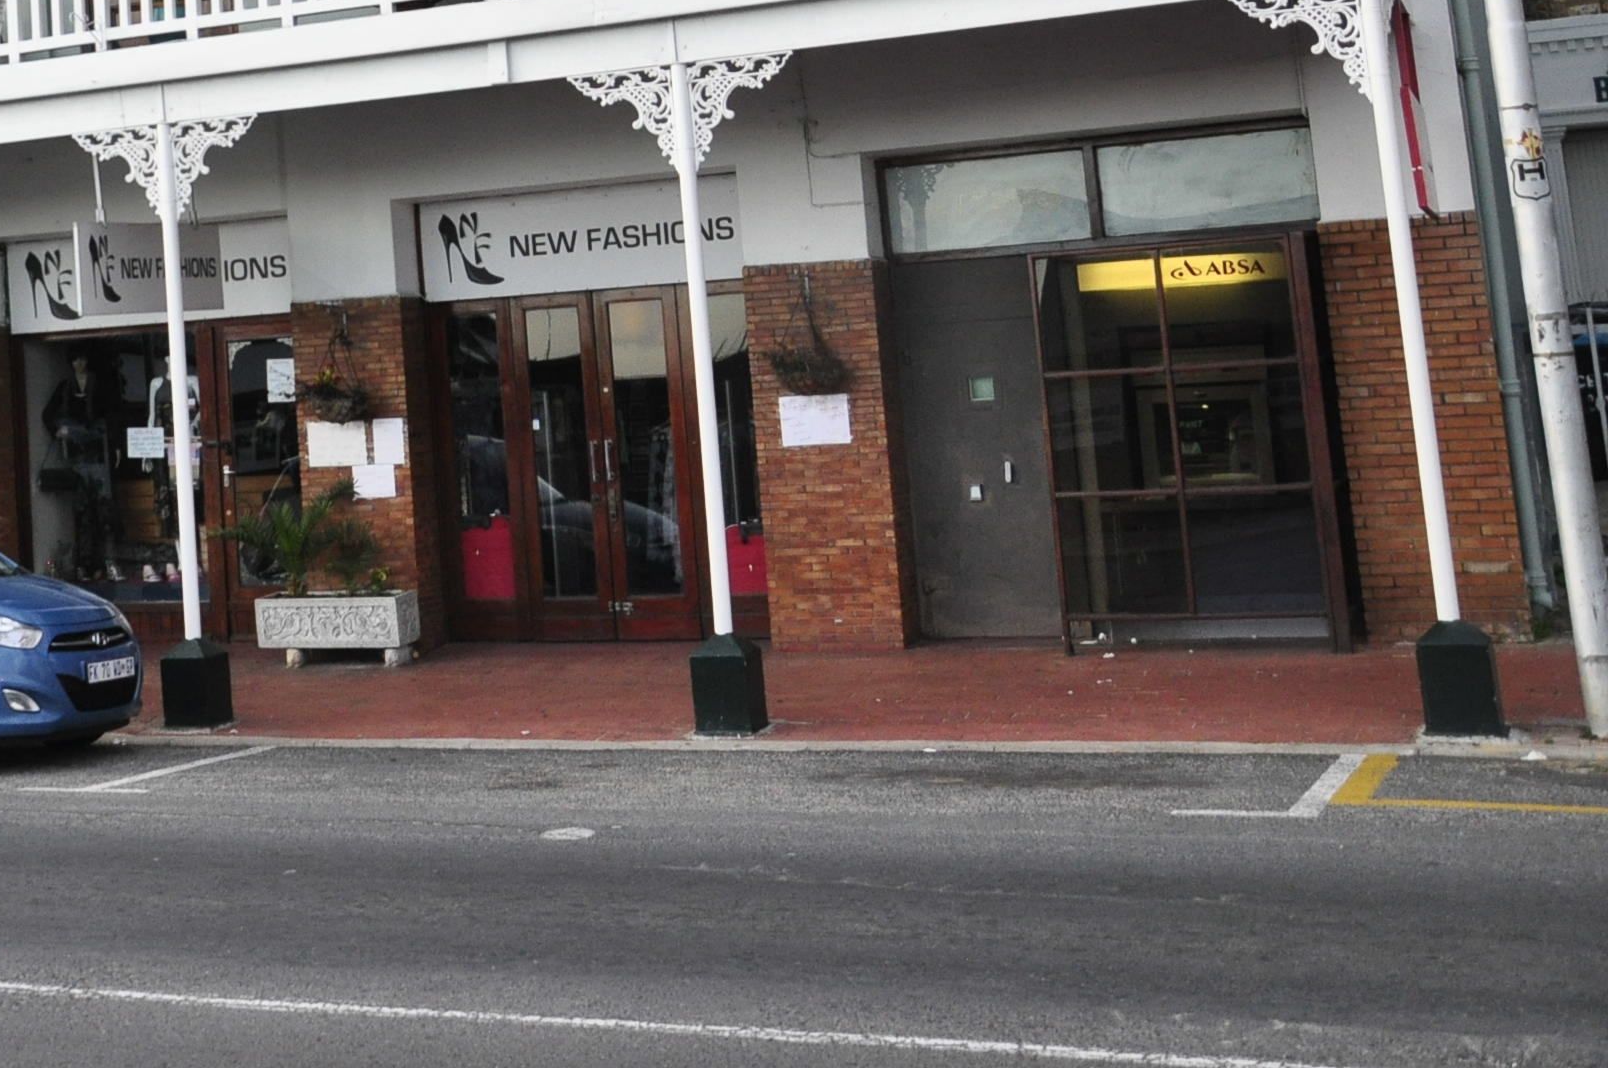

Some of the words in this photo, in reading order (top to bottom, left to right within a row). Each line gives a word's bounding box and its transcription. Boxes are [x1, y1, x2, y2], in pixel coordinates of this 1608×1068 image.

[509, 230, 577, 258] NEW
[121, 258, 152, 280] NEW
[156, 257, 217, 279] FHIONS
[1206, 259, 1266, 276] ABSA
